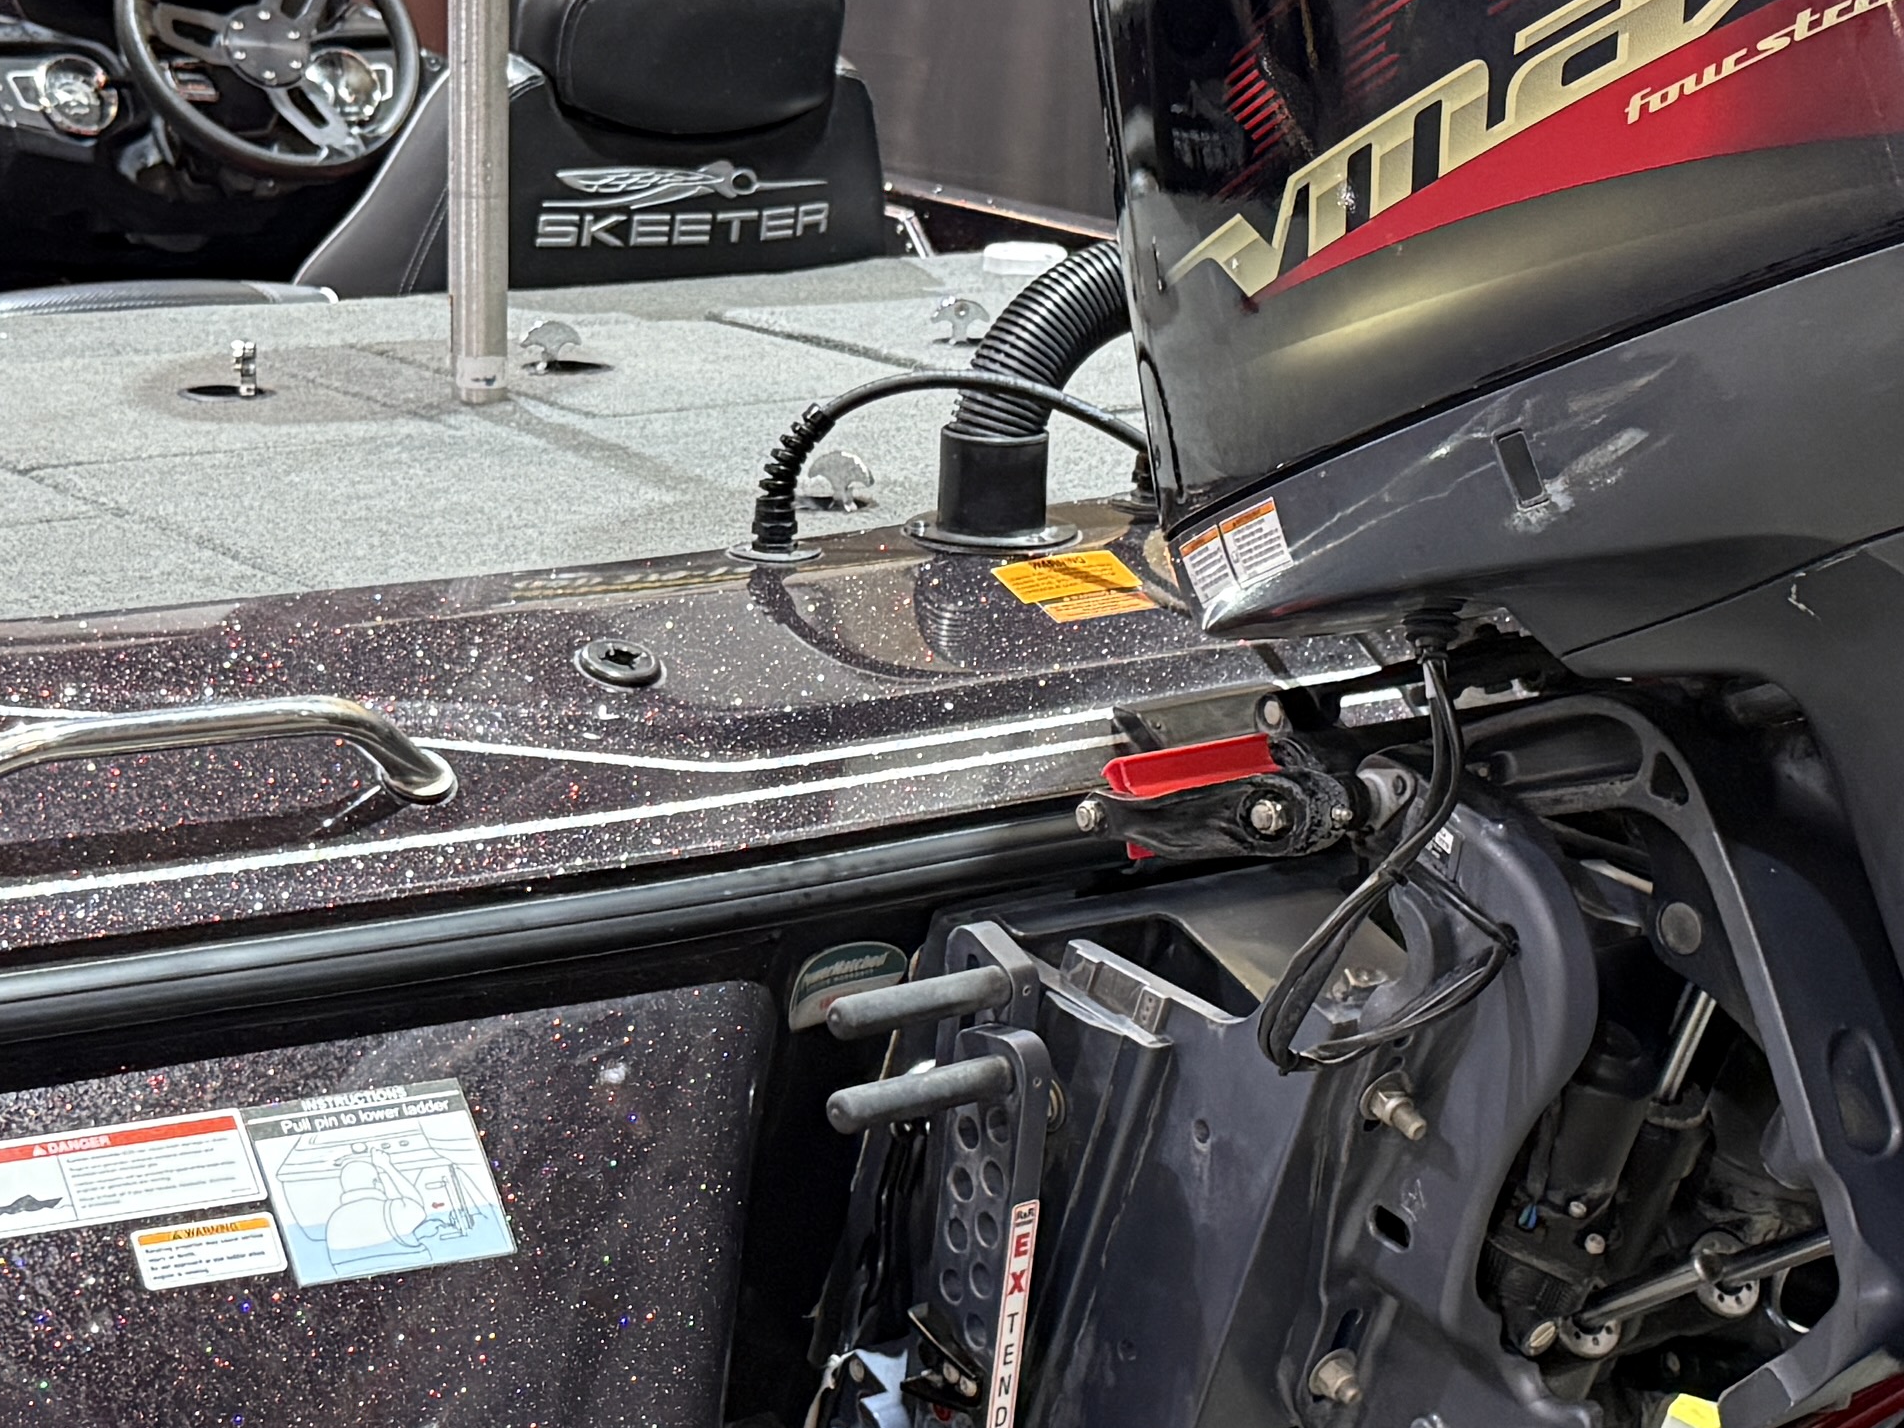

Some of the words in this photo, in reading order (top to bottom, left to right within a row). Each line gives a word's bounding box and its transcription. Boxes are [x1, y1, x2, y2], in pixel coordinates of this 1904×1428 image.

[536, 199, 830, 250] SKEETER
[301, 1085, 408, 1112] INSTRUCTIONS
[281, 1119, 312, 1135] Pull
[314, 1116, 339, 1134] pin
[341, 1113, 356, 1126] to
[359, 1106, 400, 1125] lower
[403, 1098, 451, 1119] ladder
[46, 1134, 112, 1155] DANGER
[184, 1222, 242, 1238] WARNING
